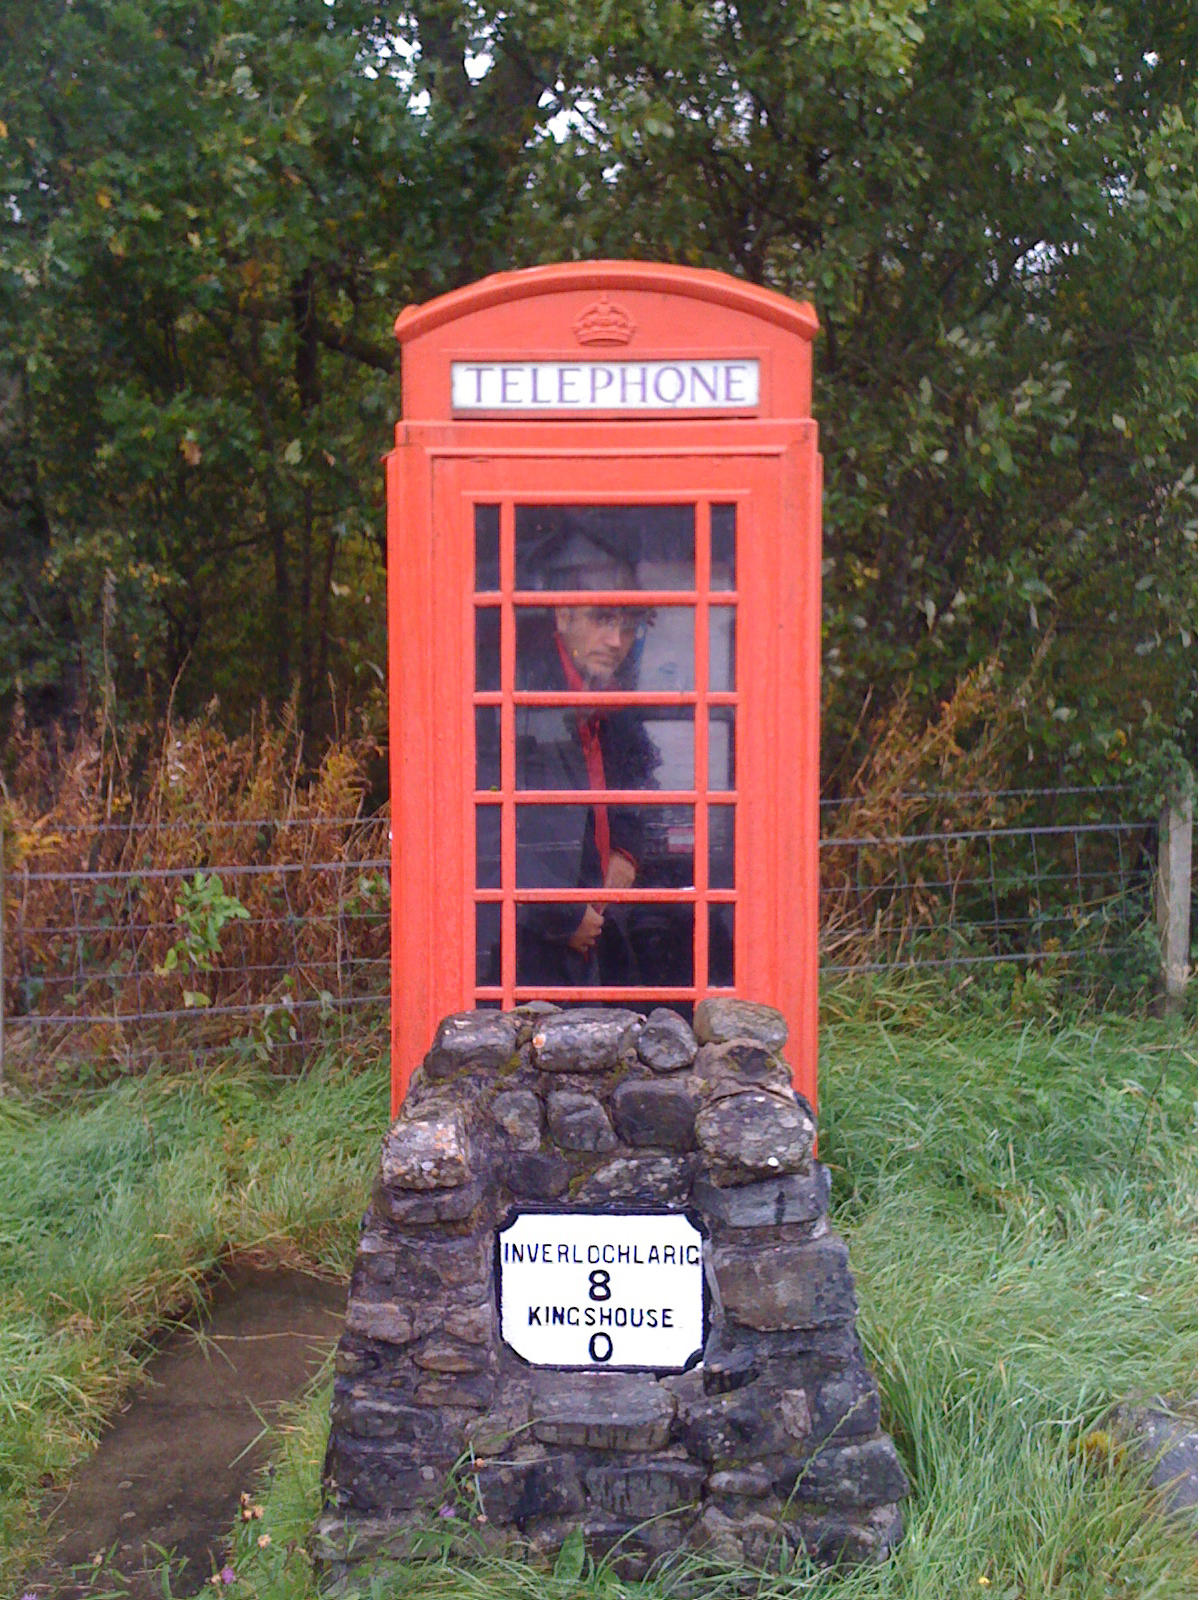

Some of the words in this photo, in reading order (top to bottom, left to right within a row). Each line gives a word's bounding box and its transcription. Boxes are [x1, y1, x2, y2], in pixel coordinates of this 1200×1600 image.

[464, 365, 748, 406] TELEPHONE
[504, 1243, 700, 1265] INVERLOCHLARIG
[588, 1269, 611, 1301] 8
[528, 1306, 674, 1328] KINGSHOUSE
[588, 1331, 613, 1362] 0
